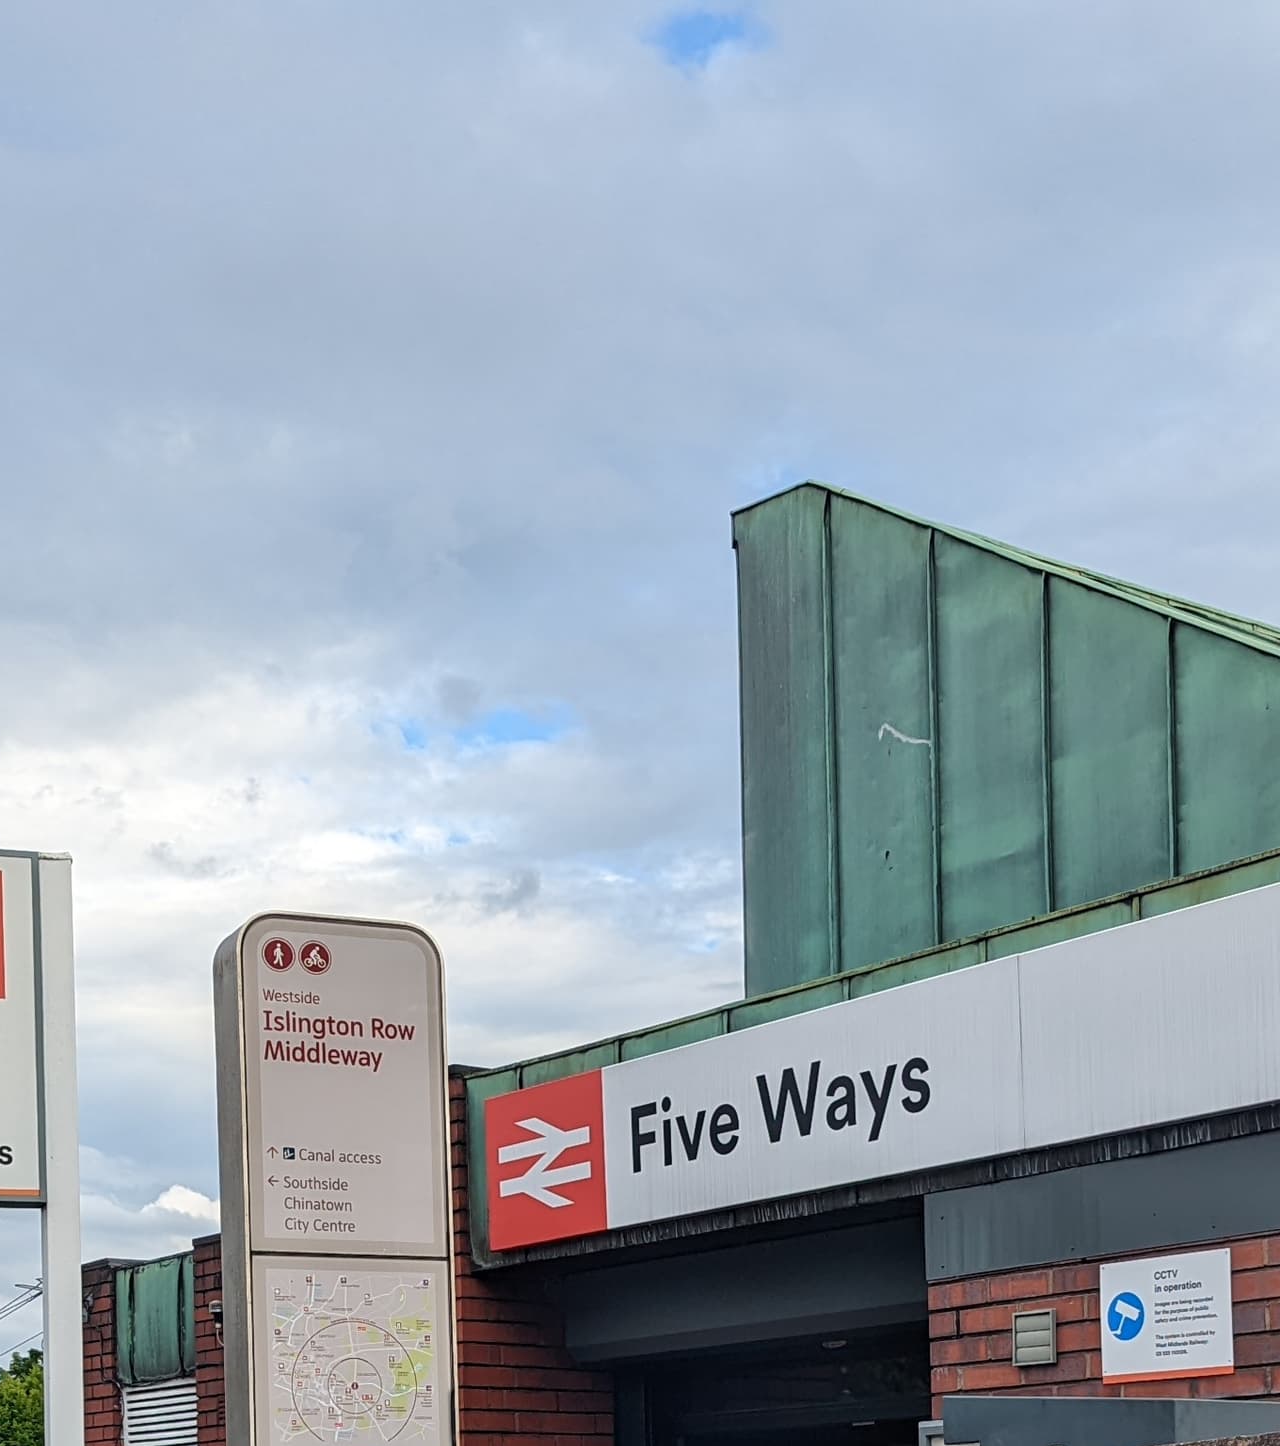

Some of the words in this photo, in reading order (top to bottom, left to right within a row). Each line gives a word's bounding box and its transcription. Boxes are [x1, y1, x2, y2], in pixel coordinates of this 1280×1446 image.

[262, 988, 320, 1005] Westside
[263, 1010, 363, 1039] Islington
[371, 1018, 414, 1040] Row
[263, 1040, 383, 1072] Middleway
[630, 1096, 740, 1173] Five
[756, 1056, 932, 1143] Ways
[299, 1148, 335, 1162] Canal
[338, 1151, 382, 1164] access
[283, 1175, 349, 1191] Southside
[284, 1197, 353, 1212] Chinatown
[284, 1218, 310, 1233] City
[313, 1219, 356, 1232] Centre
[1154, 1270, 1178, 1280] CCTV
[1155, 1284, 1162, 1293] in
[1163, 1281, 1202, 1293] operation
